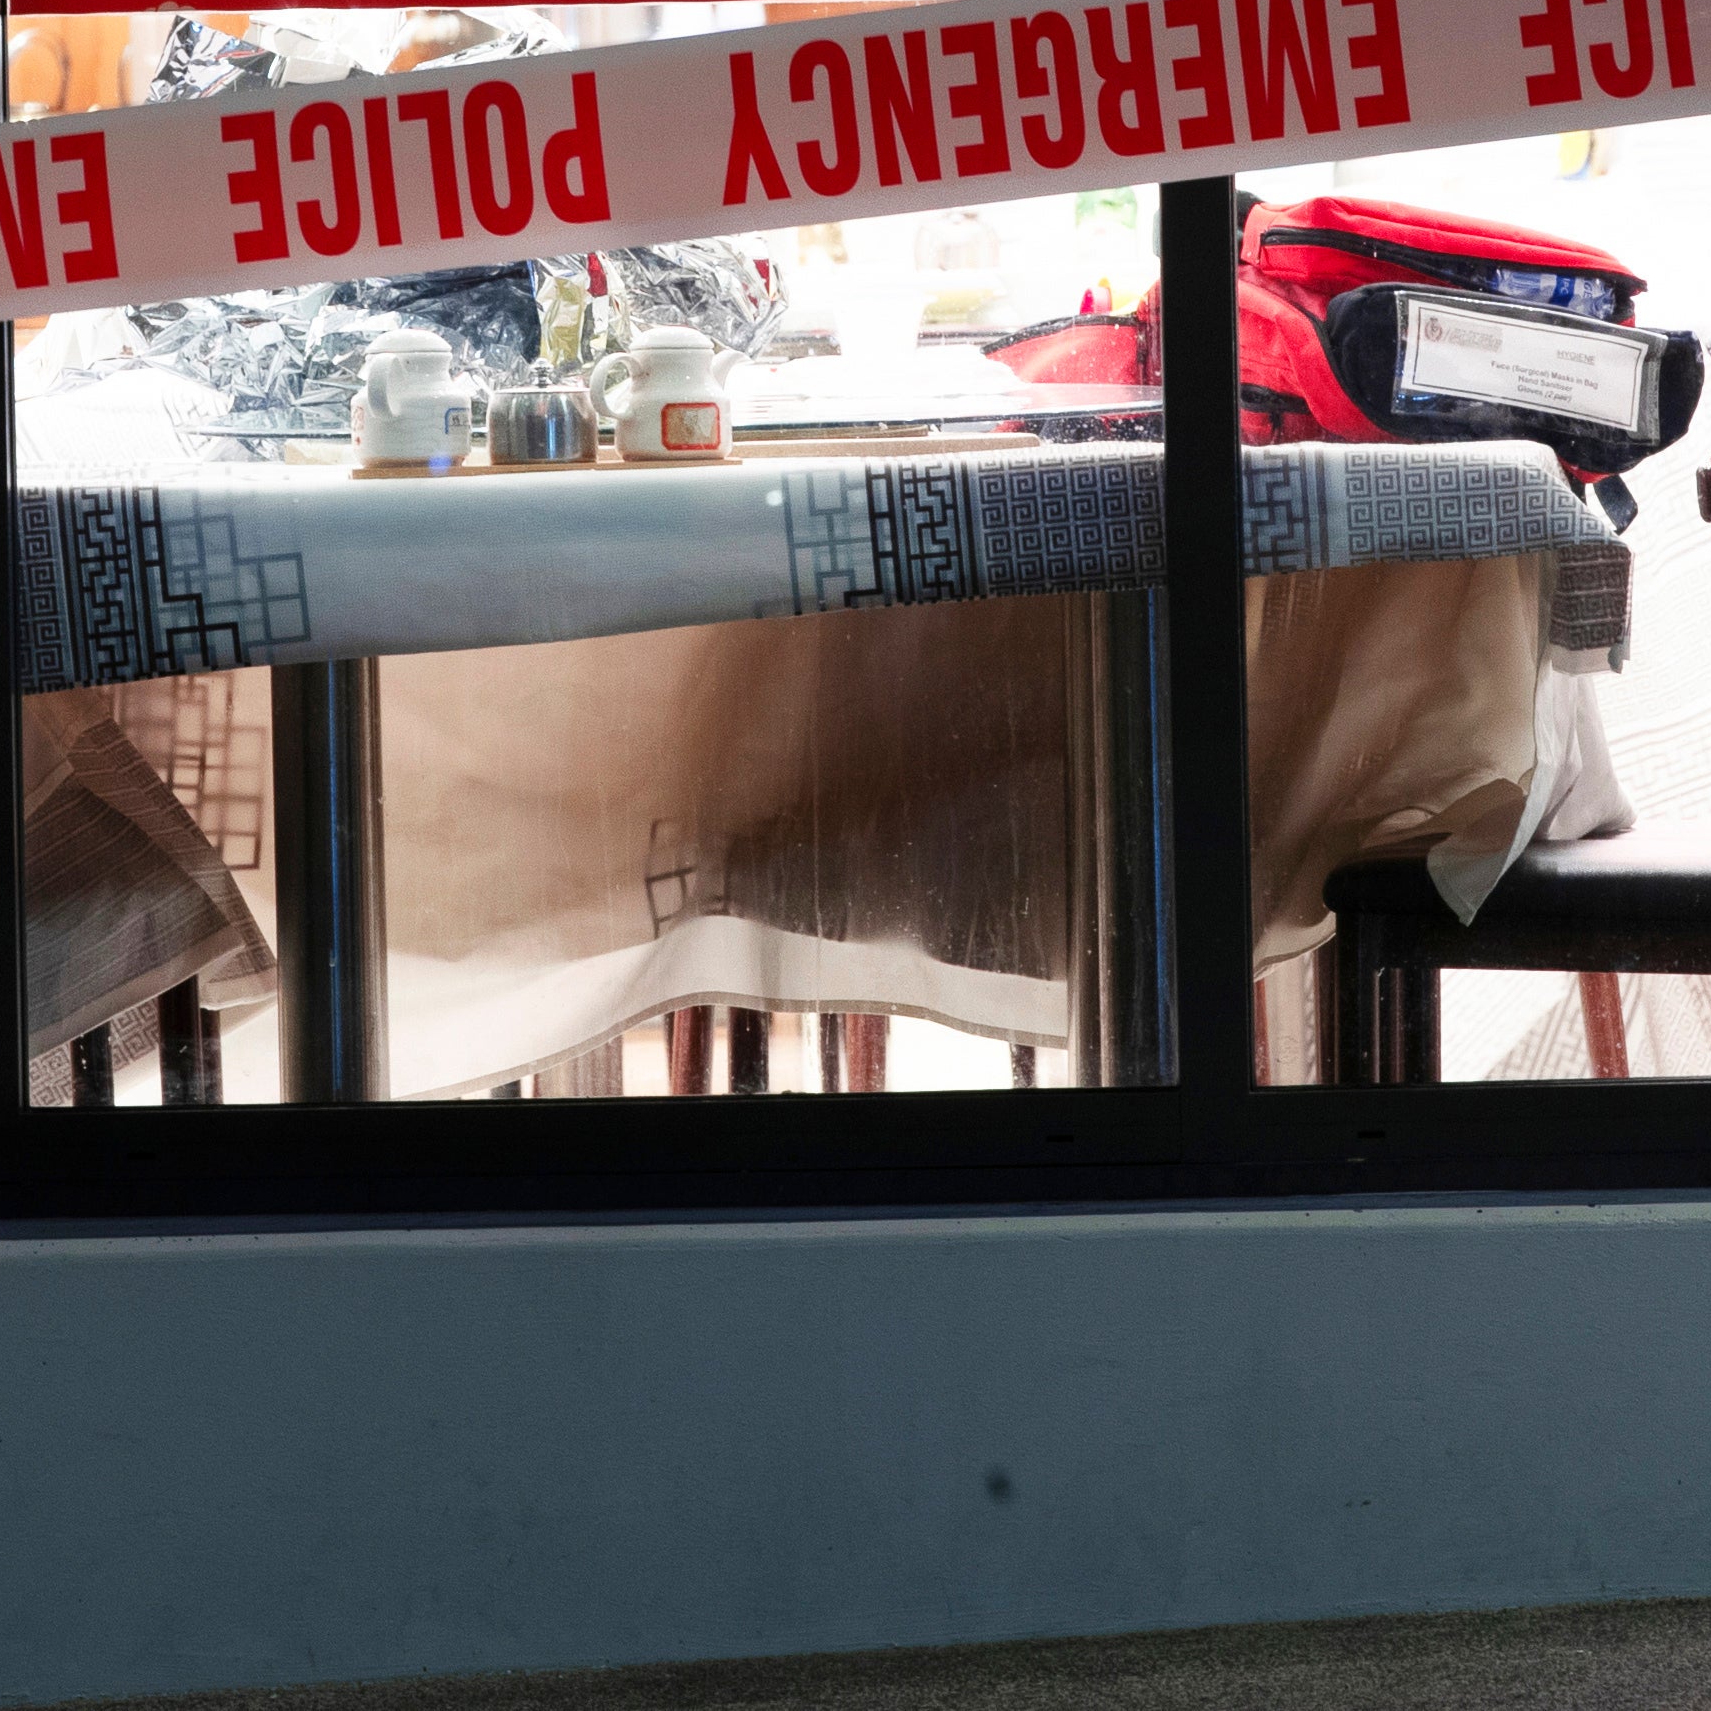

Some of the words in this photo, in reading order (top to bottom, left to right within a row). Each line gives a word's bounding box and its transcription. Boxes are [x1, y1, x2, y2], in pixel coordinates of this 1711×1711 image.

[222, 73, 610, 262] POLICE
[1557, 349, 1596, 365] HYGIENE
[1490, 360, 1511, 372] Face
[1512, 362, 1549, 379] (Surgical)
[1551, 371, 1575, 383] Masks
[1576, 376, 1583, 385] in
[1584, 378, 1598, 390] Bag
[1518, 376, 1539, 387] Hand
[1517, 385, 1543, 397] Gloves
